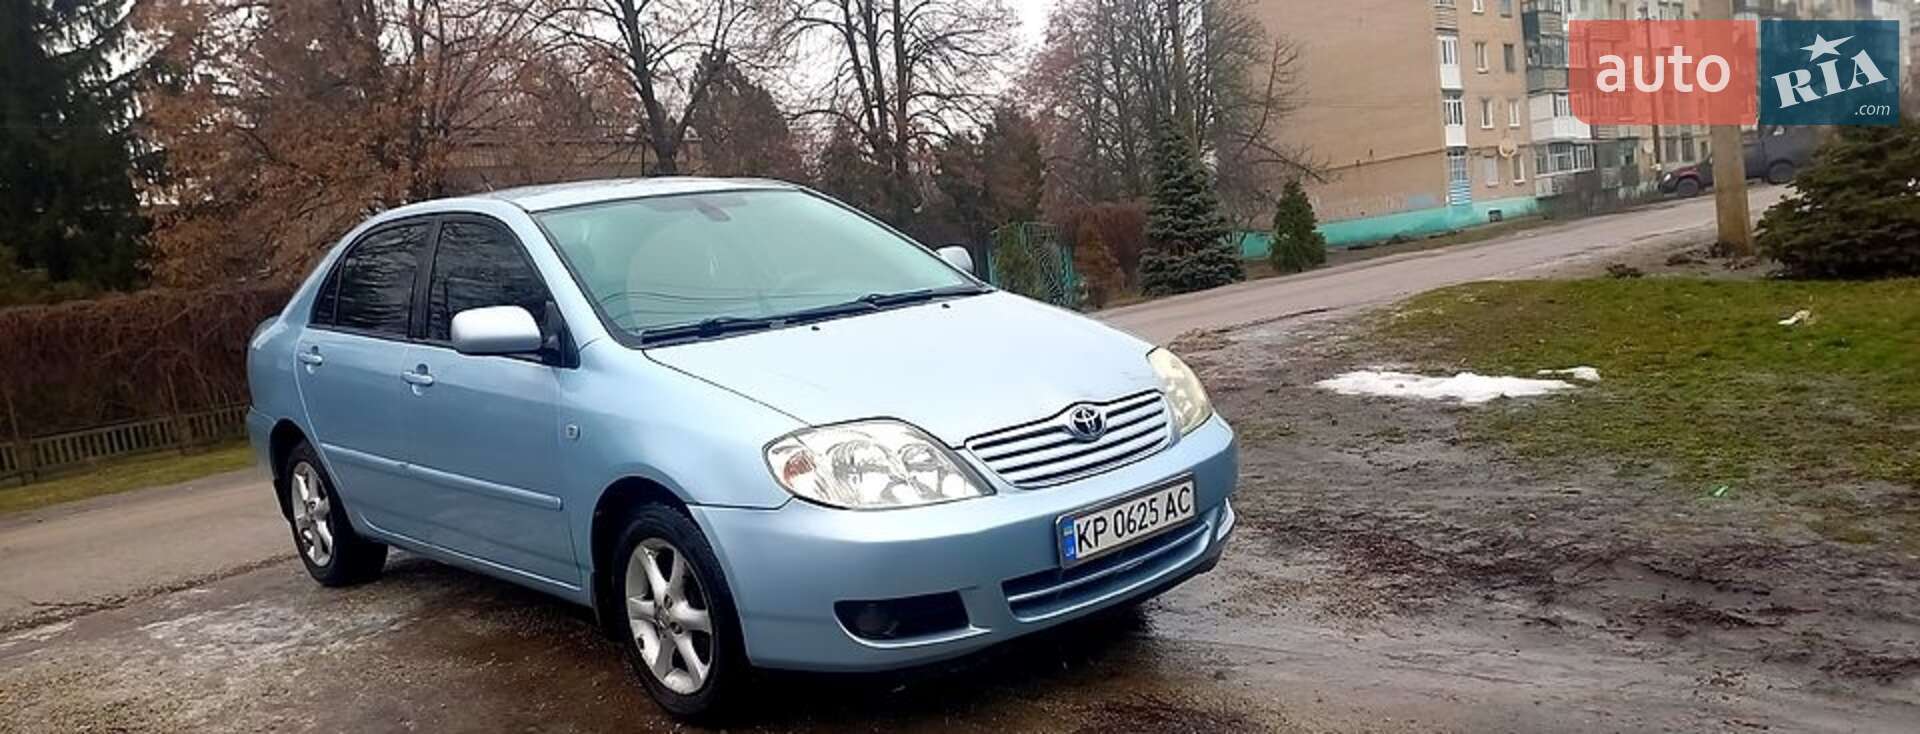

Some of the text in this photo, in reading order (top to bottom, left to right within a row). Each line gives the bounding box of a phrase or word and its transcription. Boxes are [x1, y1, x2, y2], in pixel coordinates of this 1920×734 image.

[1076, 486, 1190, 553] KP 0625 AC
